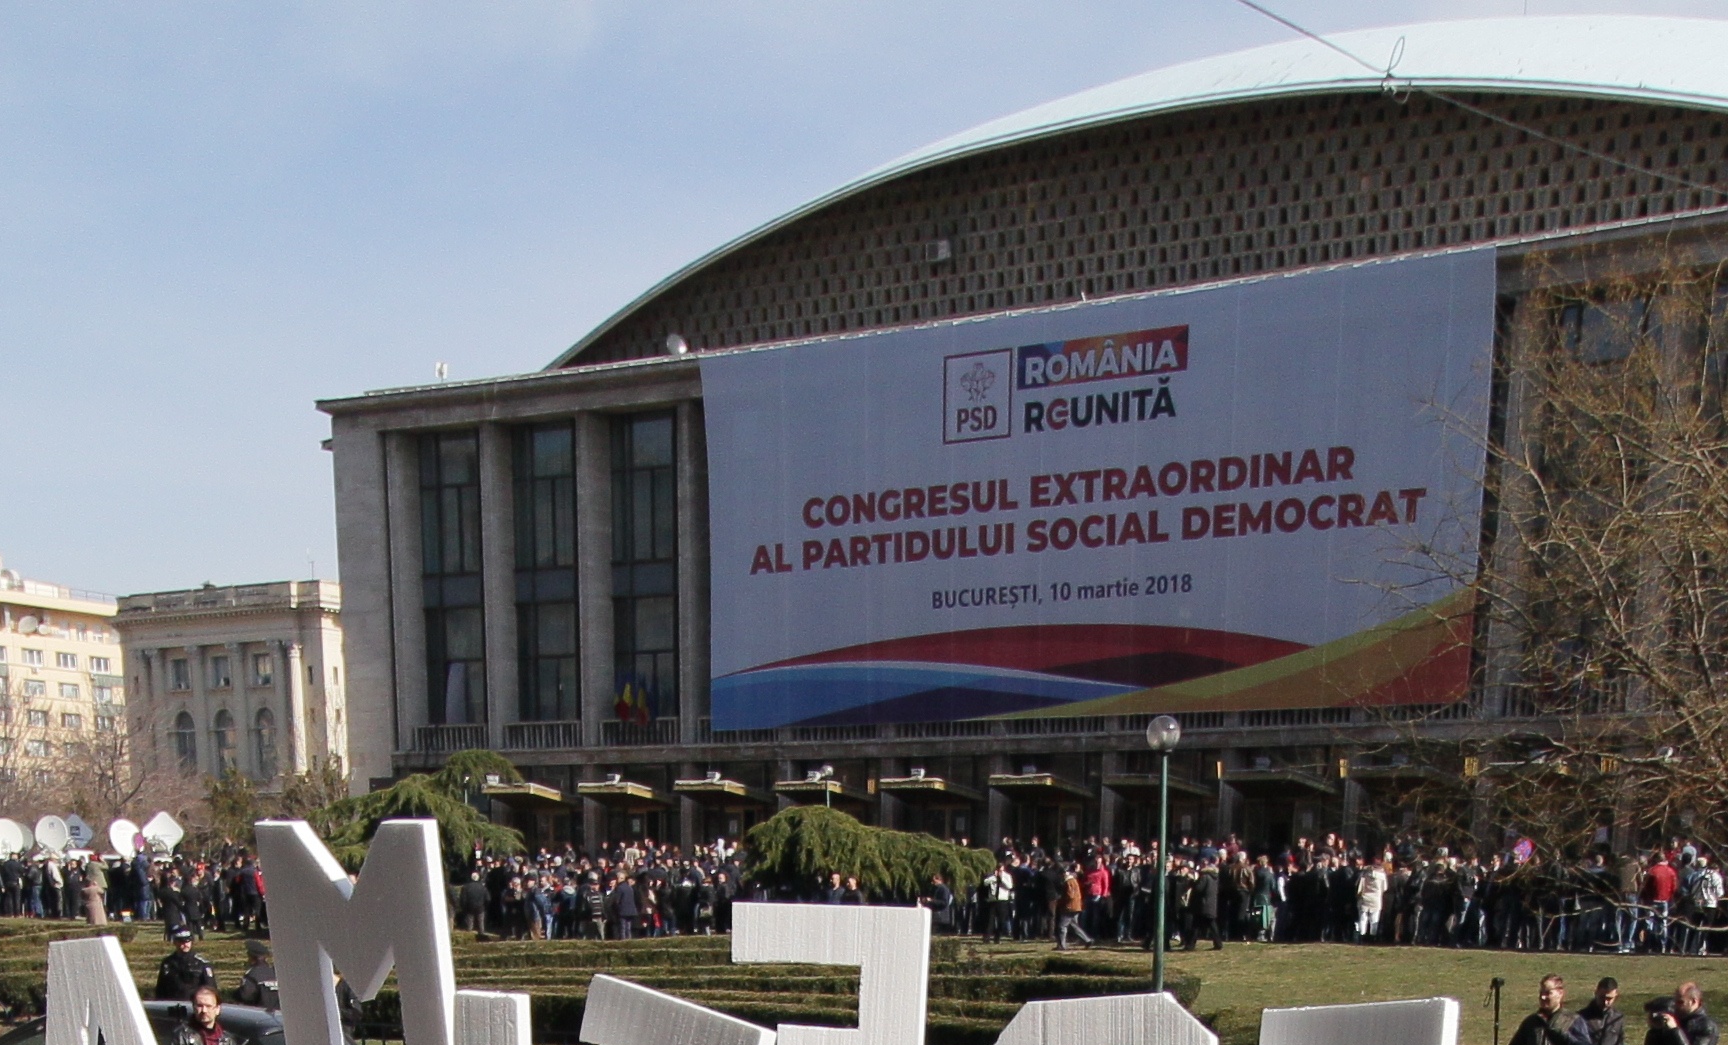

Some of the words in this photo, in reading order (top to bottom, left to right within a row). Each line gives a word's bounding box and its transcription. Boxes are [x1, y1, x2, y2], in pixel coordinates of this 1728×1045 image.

[1025, 338, 1179, 386] ROMÂNIA
[956, 405, 998, 433] PSD
[1024, 376, 1176, 433] REUNITĂ
[802, 478, 1019, 529] CONGRESUL
[1029, 446, 1356, 508] EXTRAORDINAR
[749, 543, 793, 575] AL
[801, 522, 1015, 570] PARTIDULUI
[1026, 511, 1170, 553] SOCIAL
[1181, 488, 1428, 541] DEMOCRAT
[931, 584, 1043, 609] BUCUREȘTI,
[1050, 582, 1072, 602] 10
[1076, 577, 1140, 600] martie
[1144, 573, 1193, 596] 2018
